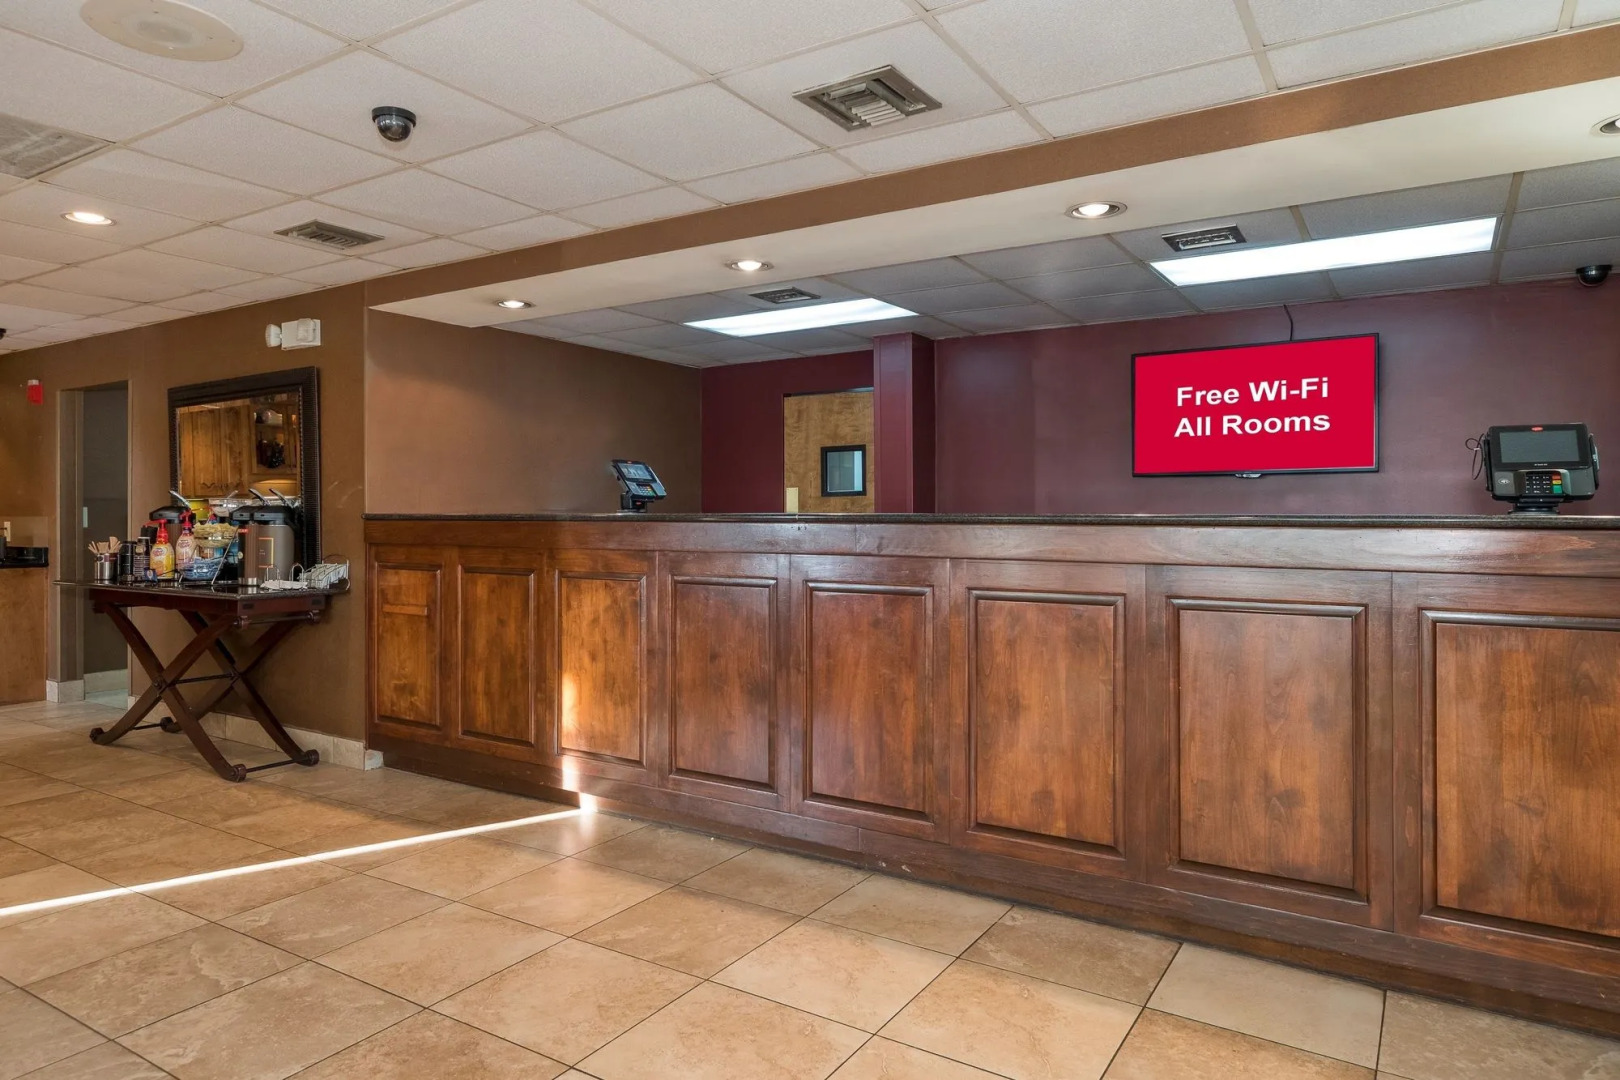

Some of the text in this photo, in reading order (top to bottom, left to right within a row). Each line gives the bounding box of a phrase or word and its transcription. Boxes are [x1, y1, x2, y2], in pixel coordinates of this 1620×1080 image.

[1177, 377, 1328, 407] Free Wi-Fi
[1174, 414, 1331, 438] All Rooms
